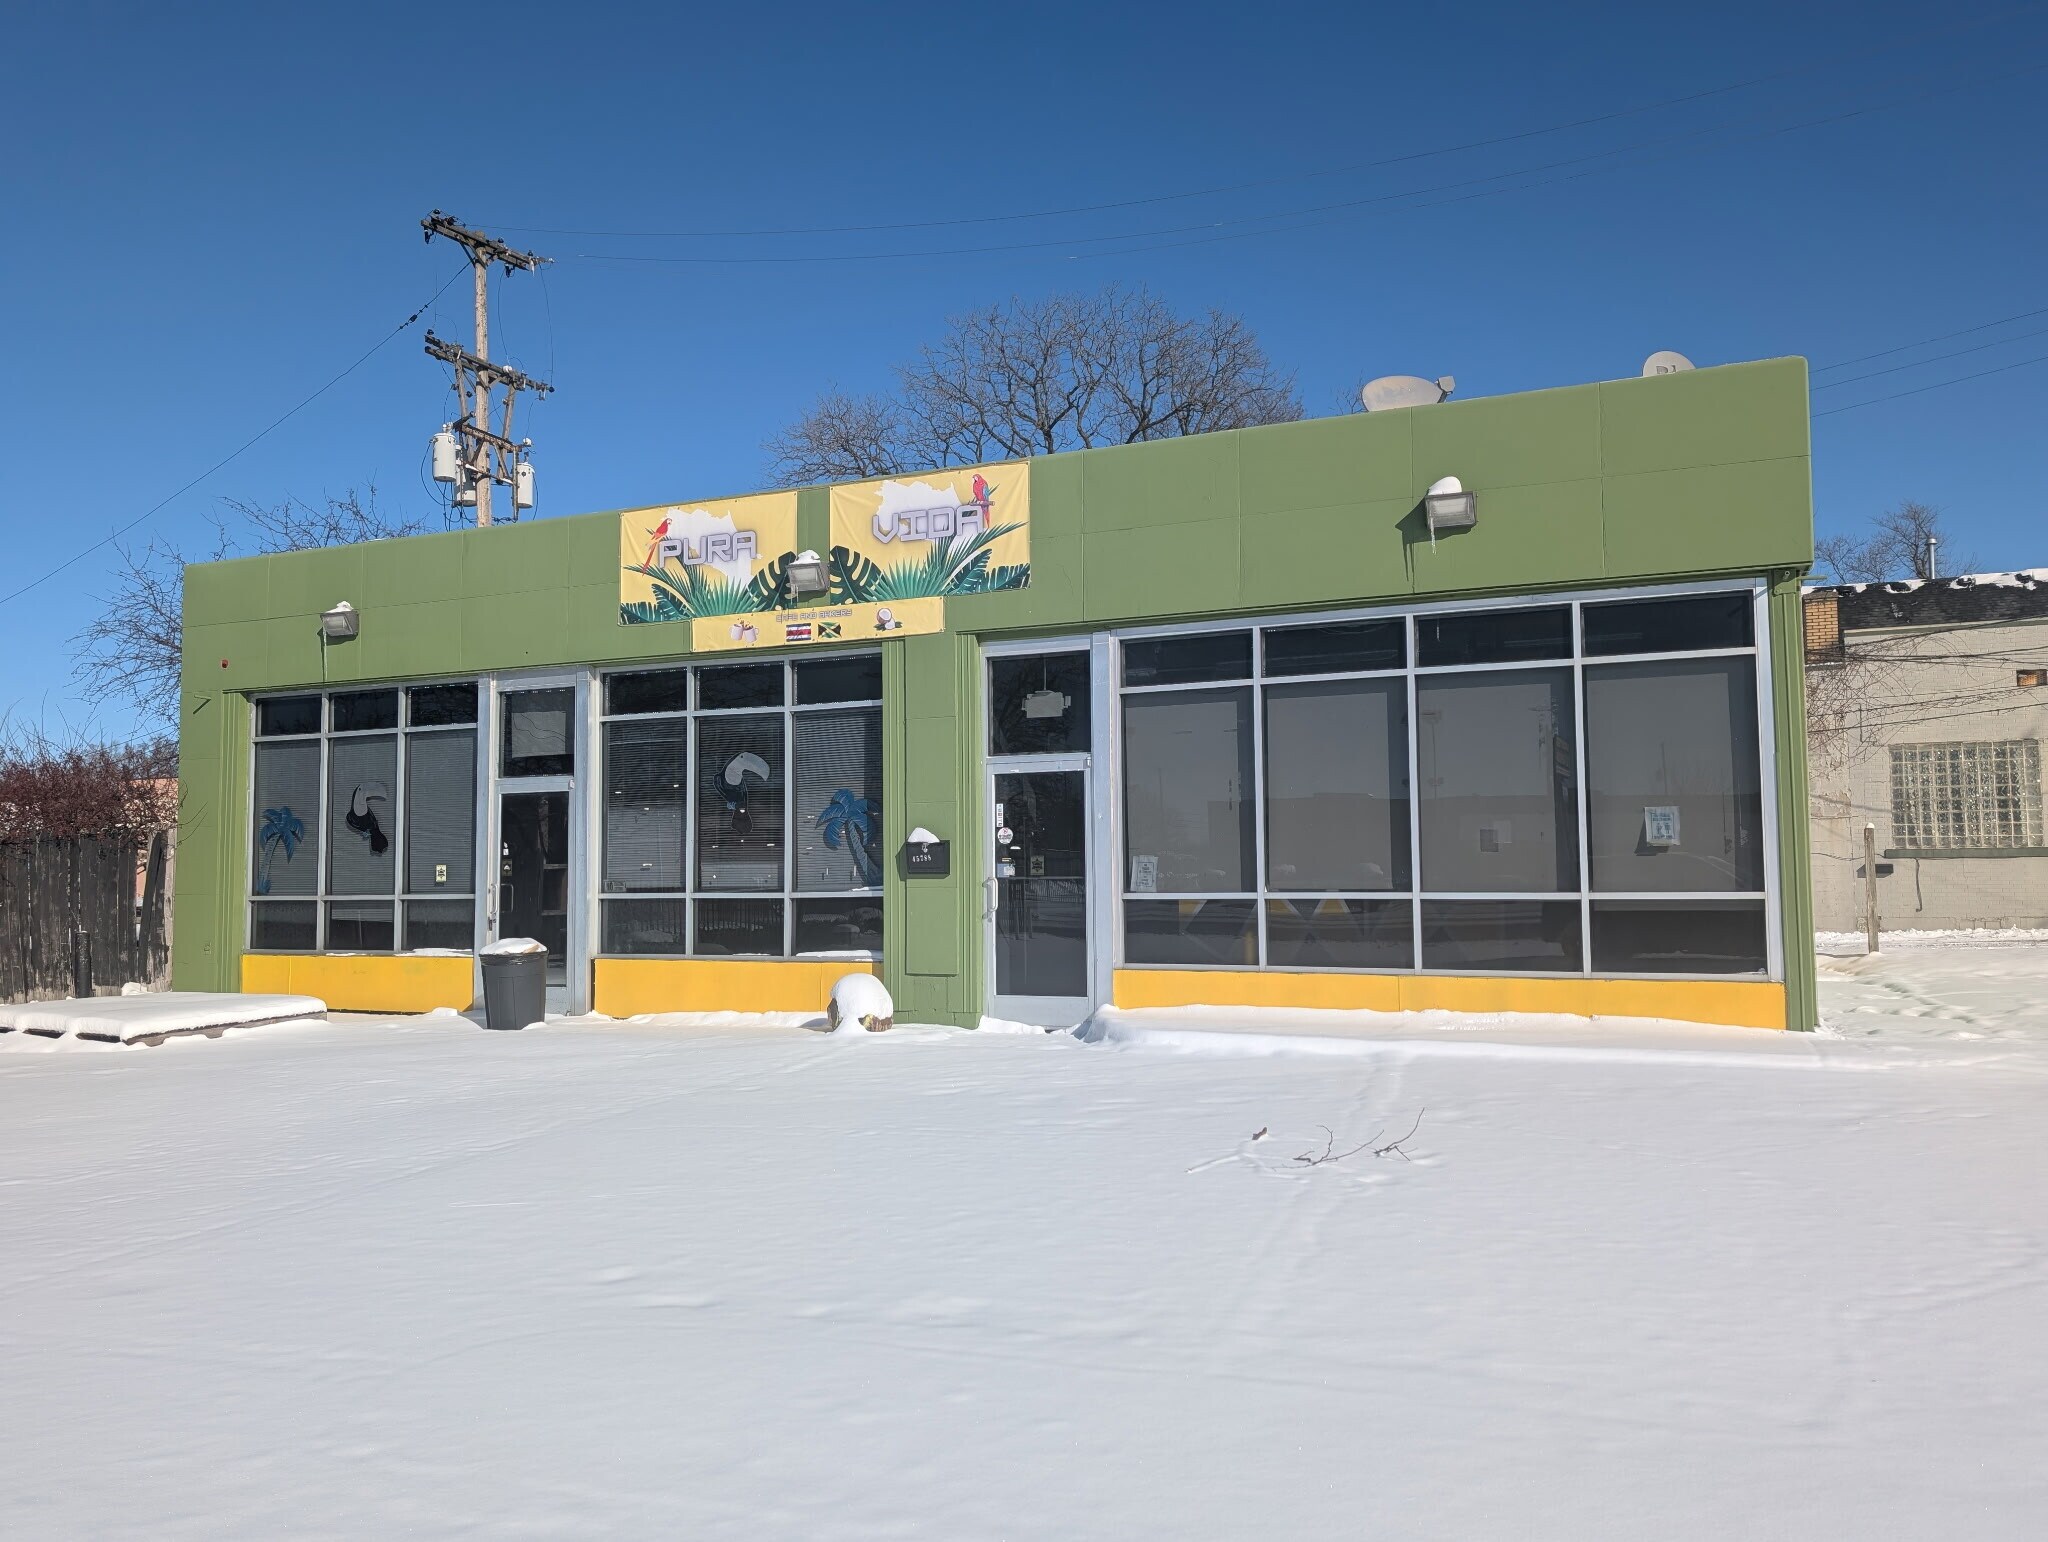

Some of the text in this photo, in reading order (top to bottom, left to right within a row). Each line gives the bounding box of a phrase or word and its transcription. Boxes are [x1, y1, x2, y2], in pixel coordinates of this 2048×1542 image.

[659, 505, 984, 567] PURA VIDA
[800, 611, 817, 620] AND
[818, 609, 852, 620] BAKERY
